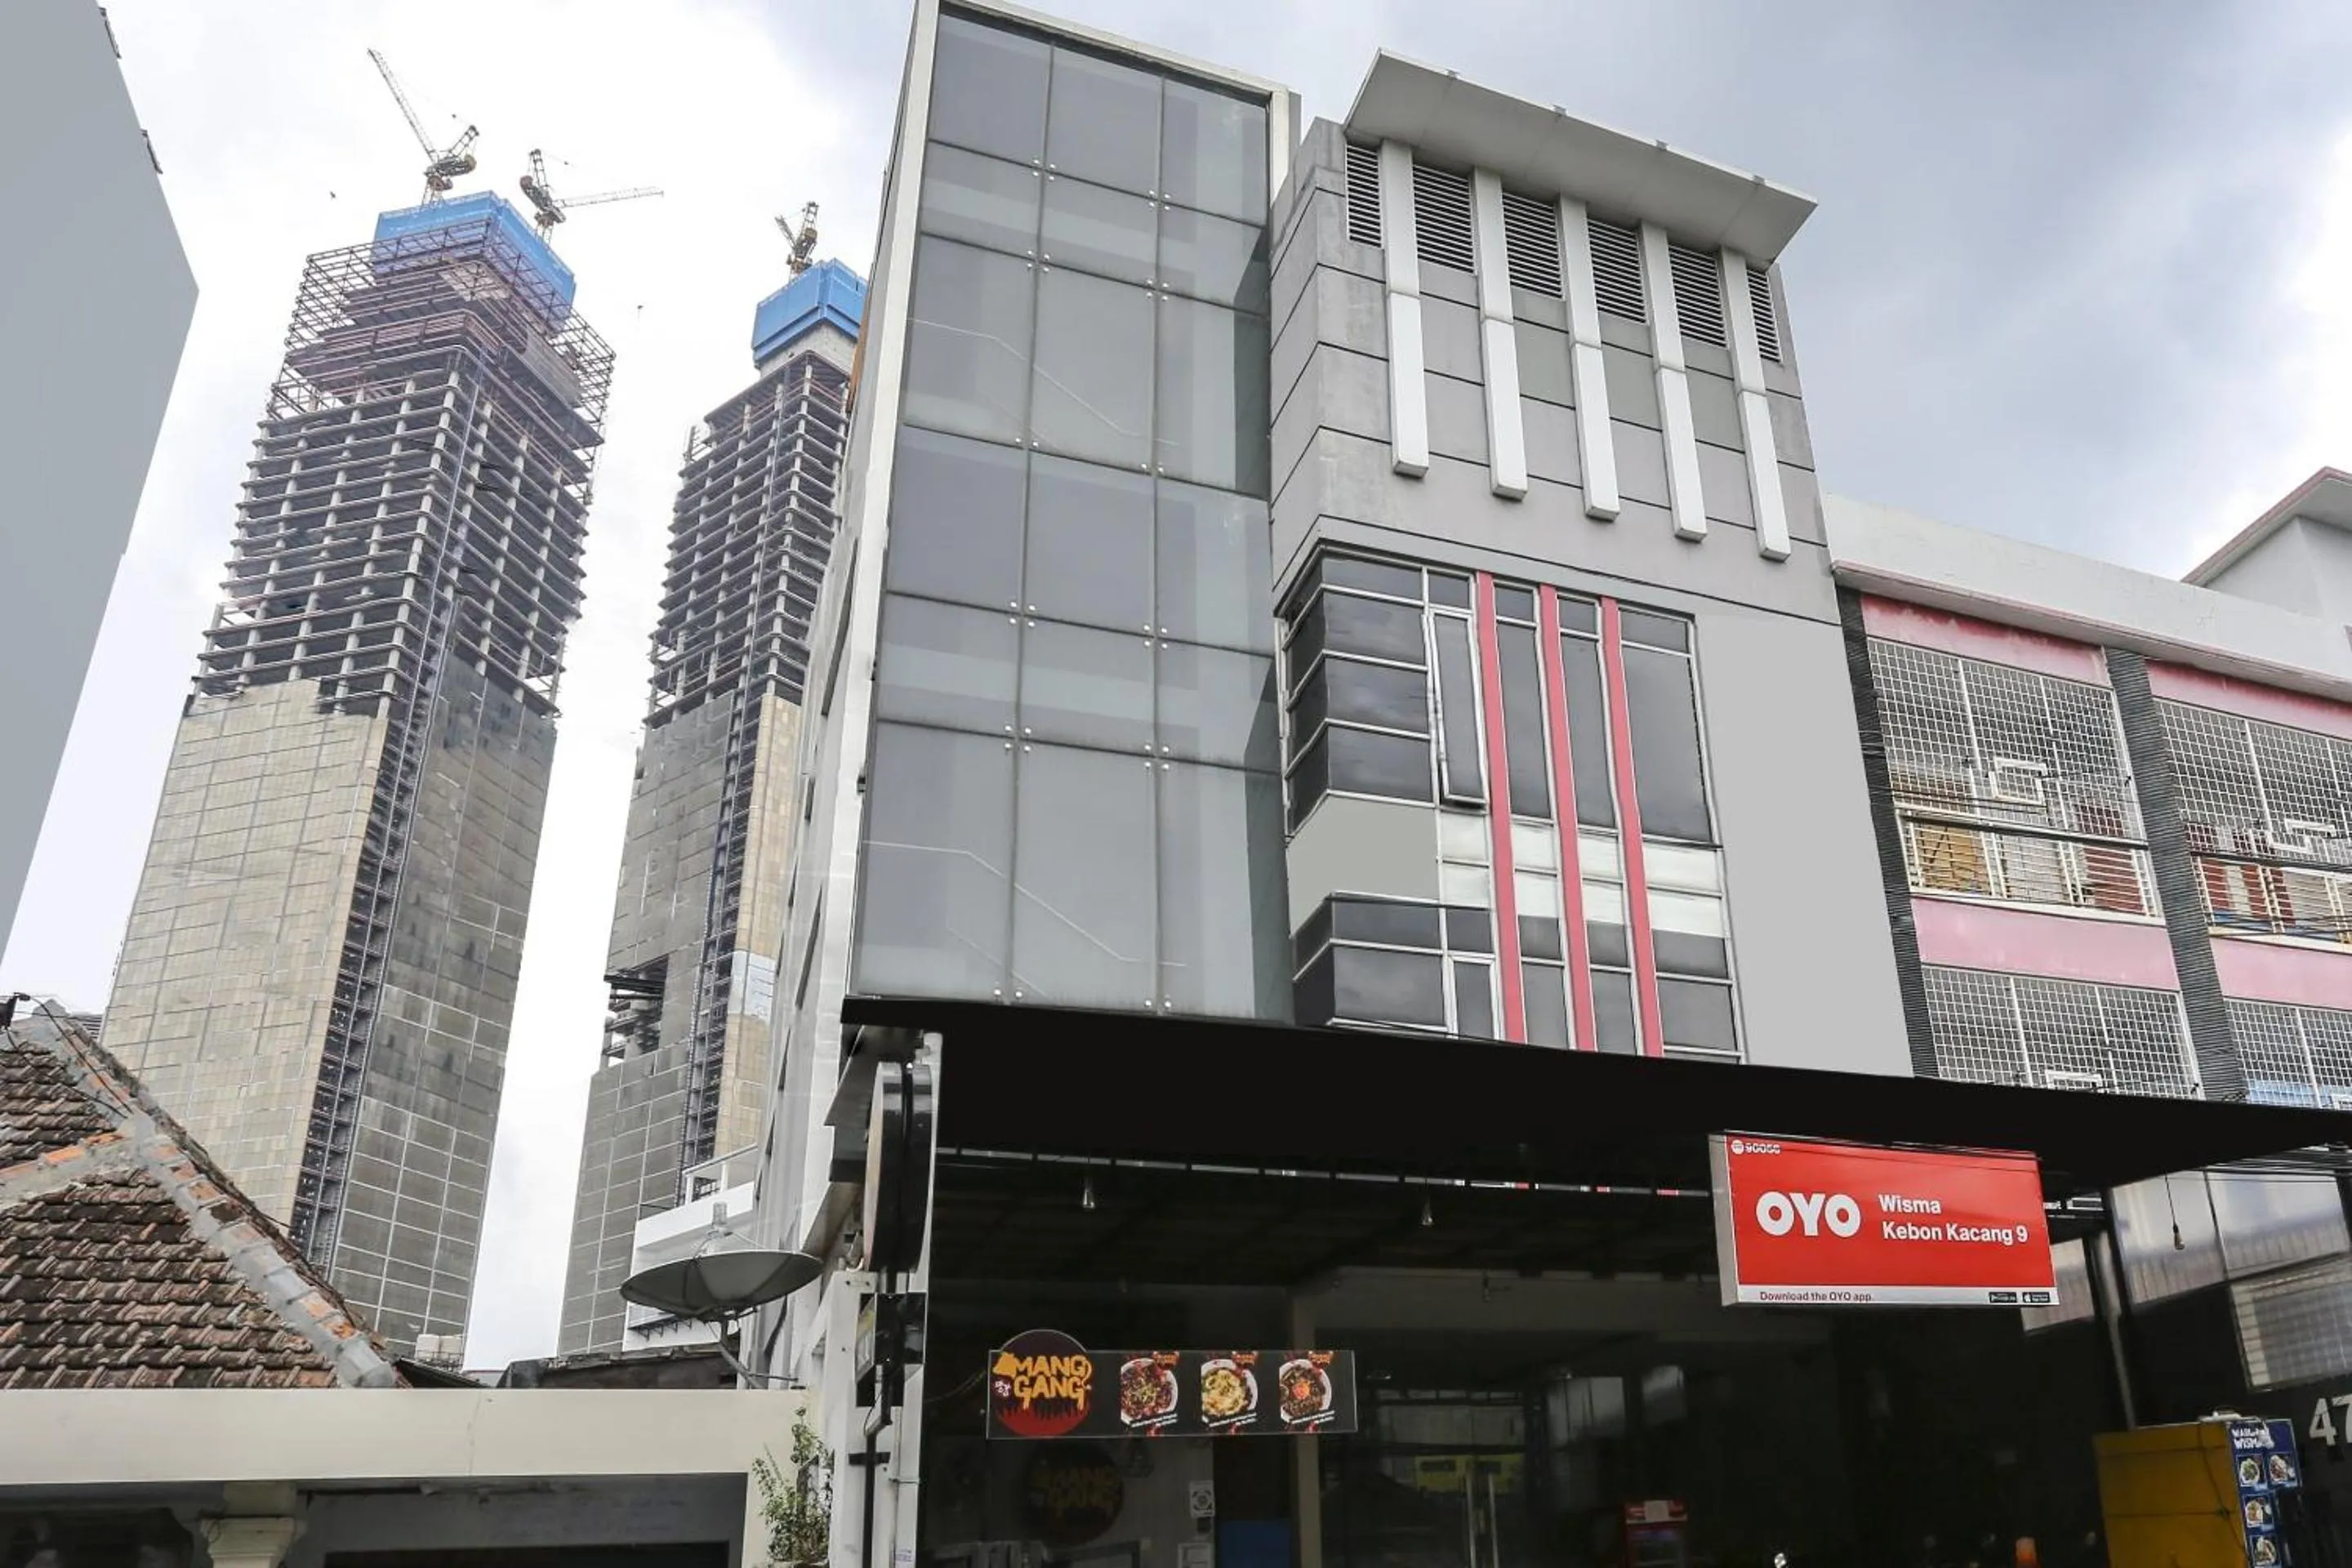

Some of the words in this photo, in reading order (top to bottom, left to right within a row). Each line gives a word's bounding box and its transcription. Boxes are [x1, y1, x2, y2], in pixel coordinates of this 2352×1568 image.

[1756, 1191, 1861, 1238] OYO
[1878, 1194, 1941, 1214] Wisma
[1882, 1221, 1942, 1241] Kebon
[1945, 1223, 2012, 1245] Kacang
[2016, 1225, 2029, 1242] 9
[1760, 1291, 1809, 1300] Download
[1811, 1292, 1827, 1301] the
[1829, 1291, 1851, 1301] OYO
[1853, 1293, 1872, 1303] app
[1014, 1355, 1087, 1377] MANG
[1014, 1374, 1085, 1411] GANG
[2310, 1393, 2352, 1446] 47
